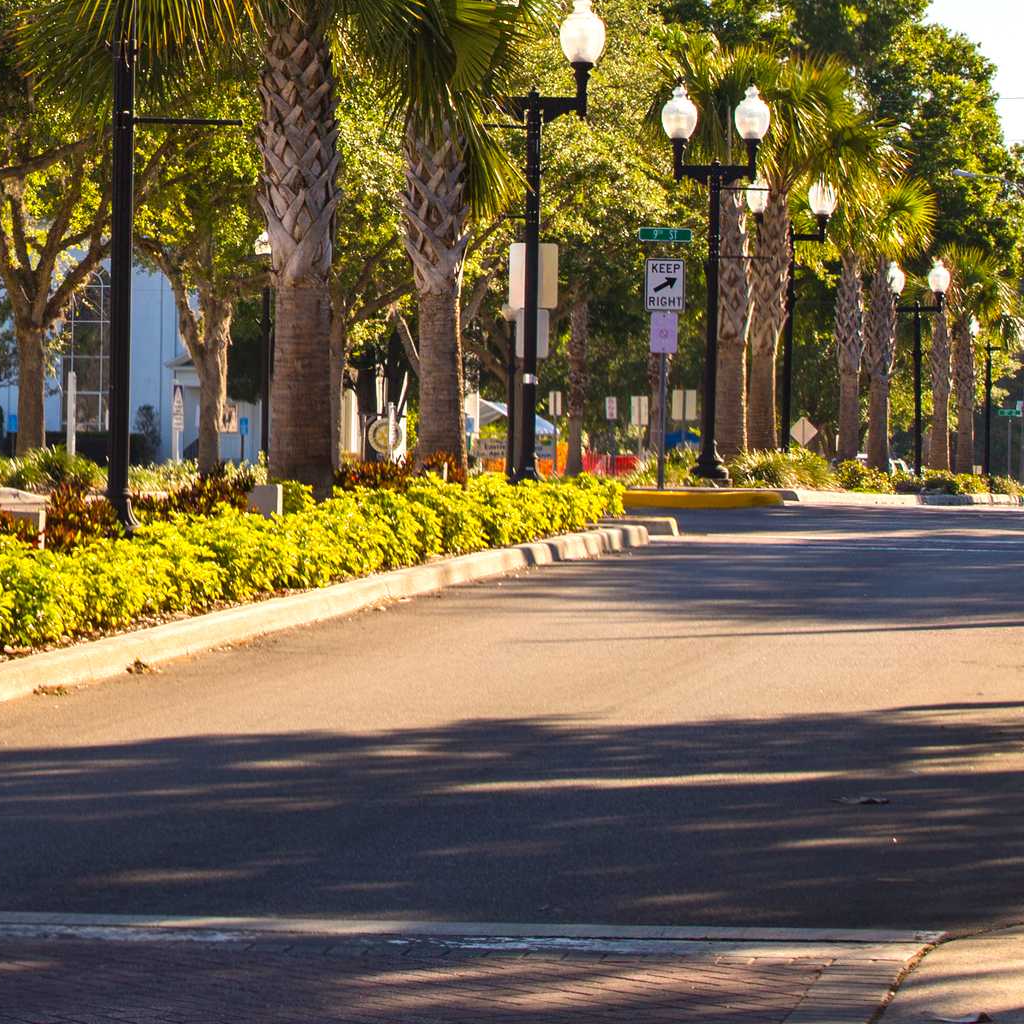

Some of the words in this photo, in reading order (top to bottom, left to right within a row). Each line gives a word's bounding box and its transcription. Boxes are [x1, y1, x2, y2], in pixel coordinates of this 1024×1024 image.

[669, 230, 679, 241] ST
[651, 263, 681, 274] KEEP
[648, 296, 682, 307] RIGHT
